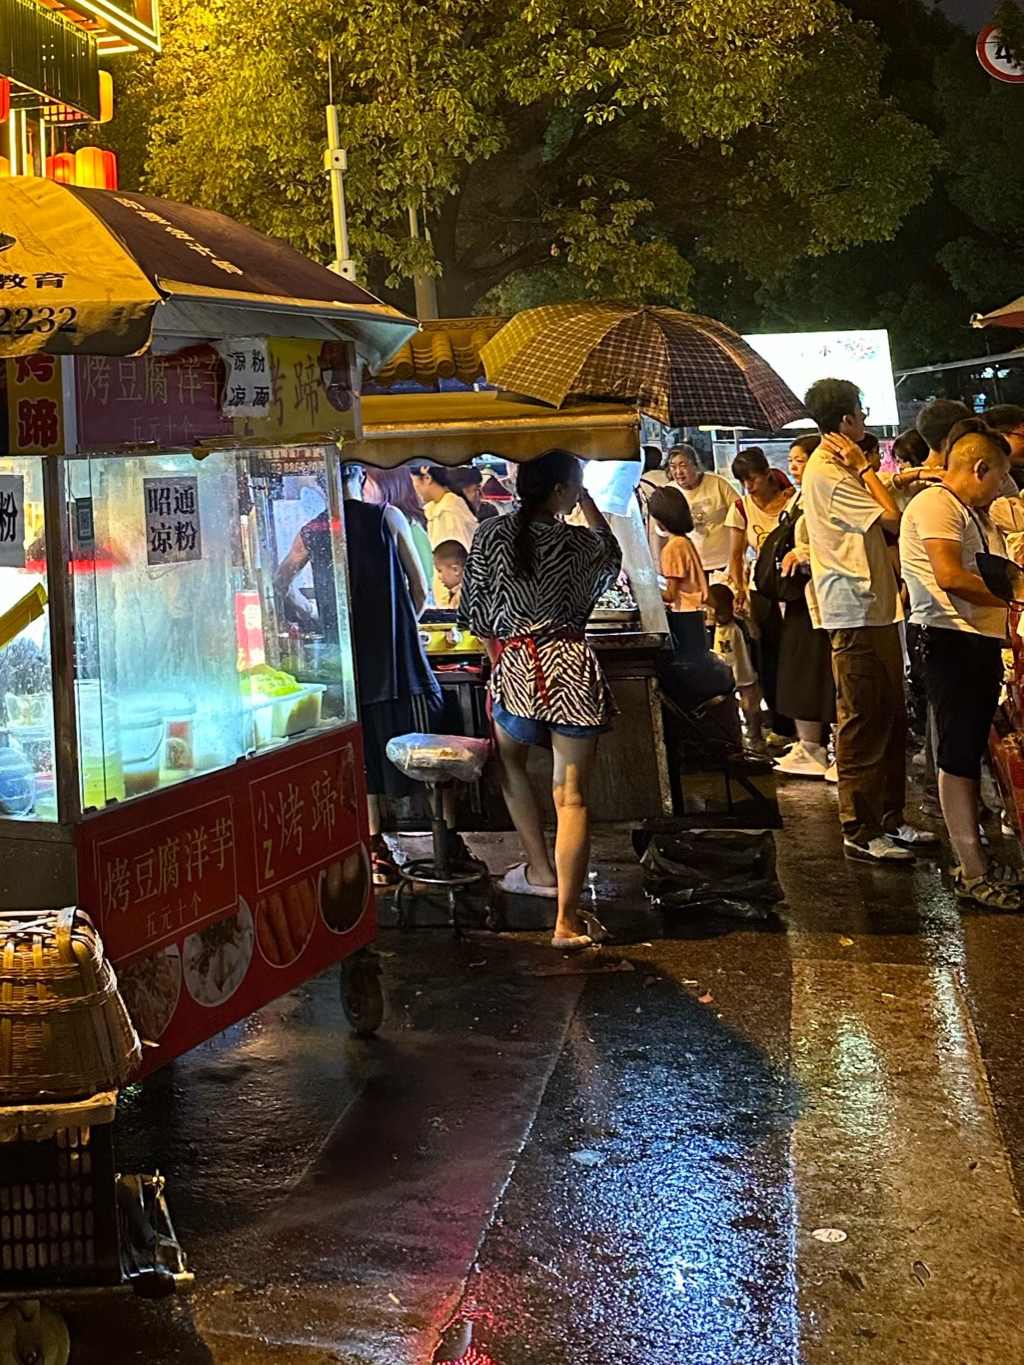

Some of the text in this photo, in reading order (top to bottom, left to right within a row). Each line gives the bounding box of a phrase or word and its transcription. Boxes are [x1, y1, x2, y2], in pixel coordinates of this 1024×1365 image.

[227, 349, 266, 373] 凉粉
[82, 354, 225, 405] 烤豆腐洋芋
[228, 385, 270, 408] 凉面
[129, 414, 194, 443] 五元十个
[148, 485, 197, 517] 昭通
[150, 521, 198, 555] 凉粉
[276, 770, 337, 856] 烤蹄
[103, 817, 233, 921] 烤豆腐洋芋
[145, 890, 202, 939] 五元十个
